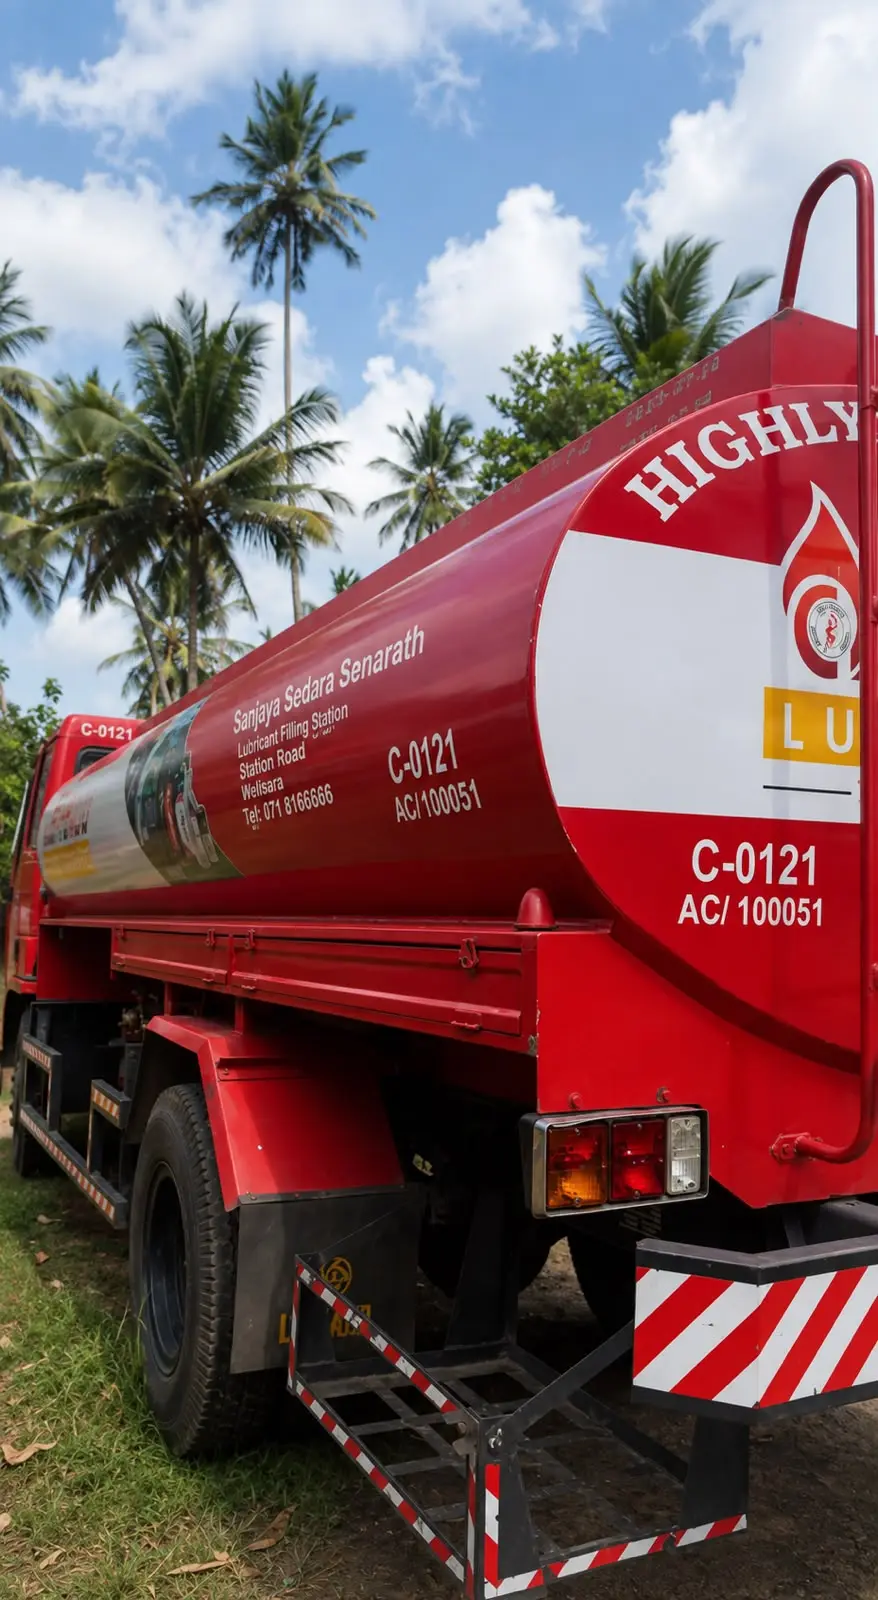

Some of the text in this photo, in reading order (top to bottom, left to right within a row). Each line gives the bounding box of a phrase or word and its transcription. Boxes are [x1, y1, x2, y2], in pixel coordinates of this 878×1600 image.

[623, 401, 858, 523] HIGHLY
[233, 624, 425, 734] Sanjaya Sedara Senarath
[81, 722, 133, 740] C-0121
[238, 730, 279, 759] Lubricant
[280, 719, 309, 739] Filling
[311, 704, 349, 730] Station
[239, 741, 306, 780] Station Road
[388, 728, 458, 784] C-0121
[241, 776, 284, 801] Welisara
[242, 783, 334, 825] Tel: 071 8166666
[691, 838, 816, 886] C-0121
[738, 895, 823, 927] 100051
